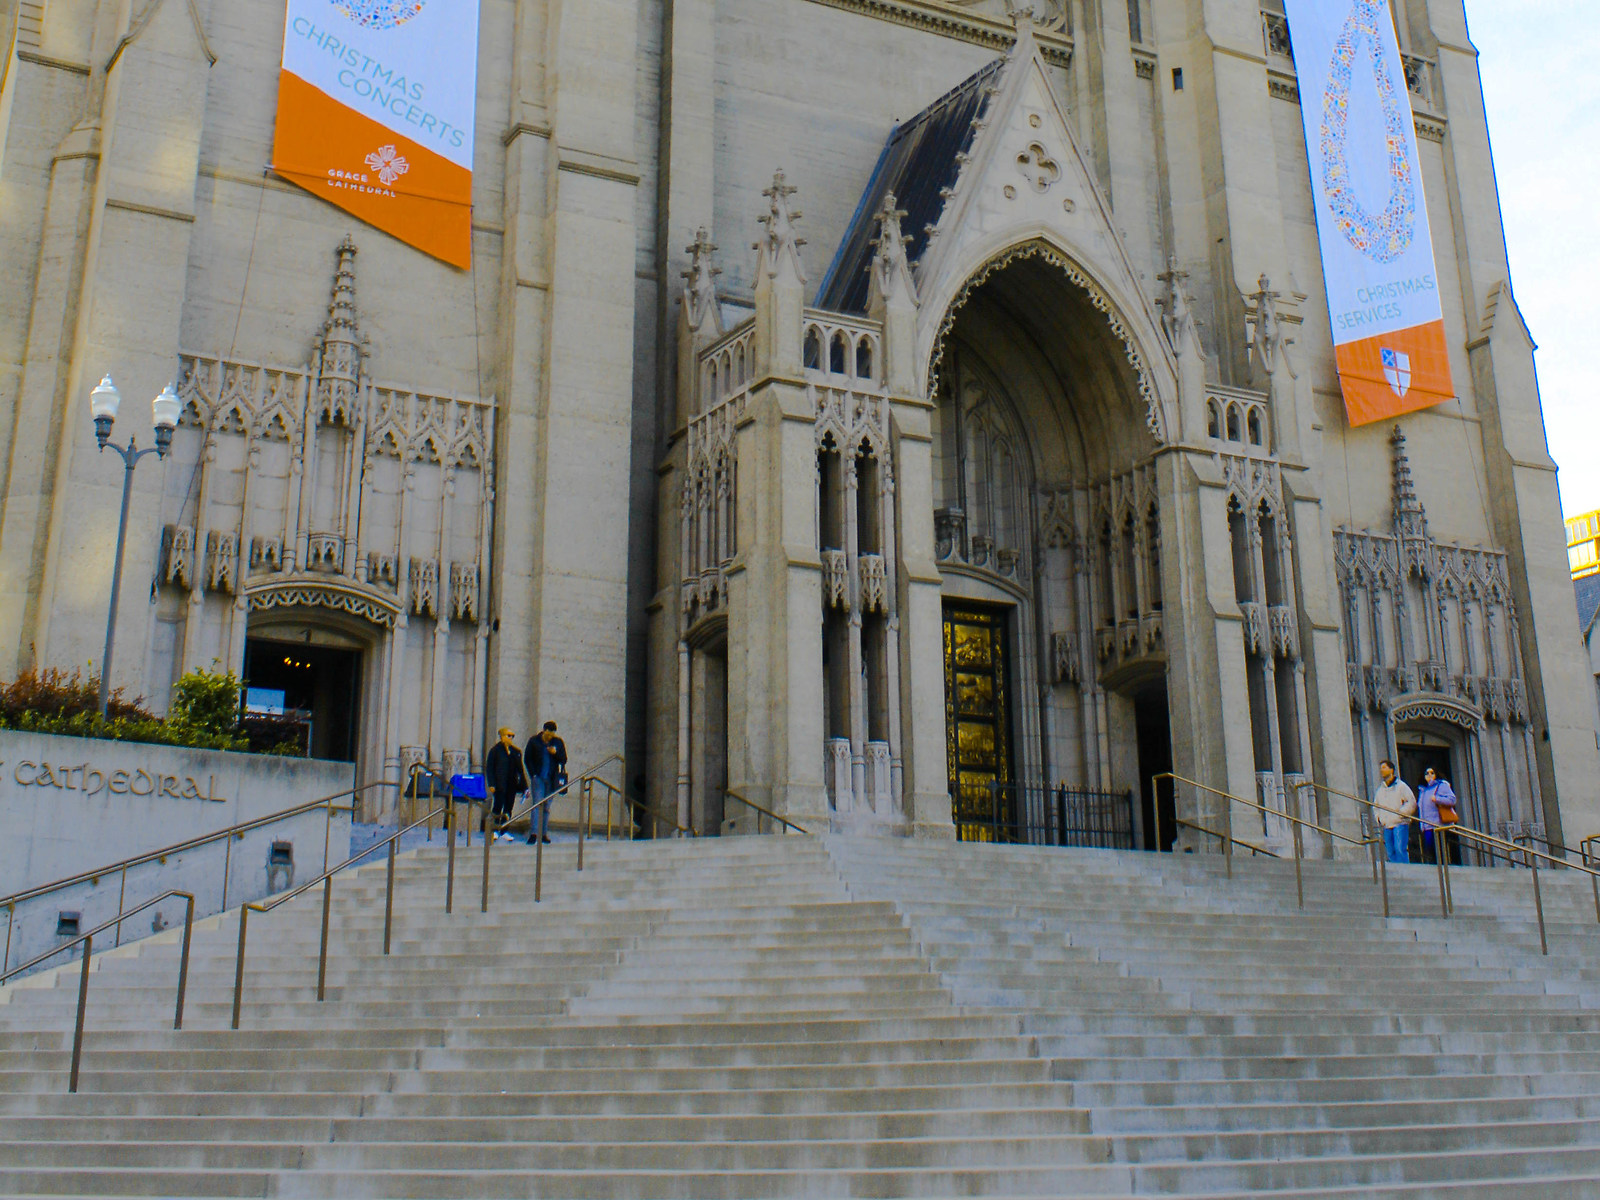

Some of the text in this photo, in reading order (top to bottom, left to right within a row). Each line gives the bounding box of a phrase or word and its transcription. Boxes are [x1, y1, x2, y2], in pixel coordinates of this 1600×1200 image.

[292, 16, 425, 101] CHRISTMAS
[337, 69, 466, 148] CONCERTS
[327, 168, 368, 183] GRACE
[327, 180, 396, 198] CATHEDRAL
[1356, 275, 1435, 304] CHRISTMAS
[1336, 302, 1402, 330] SERVICES
